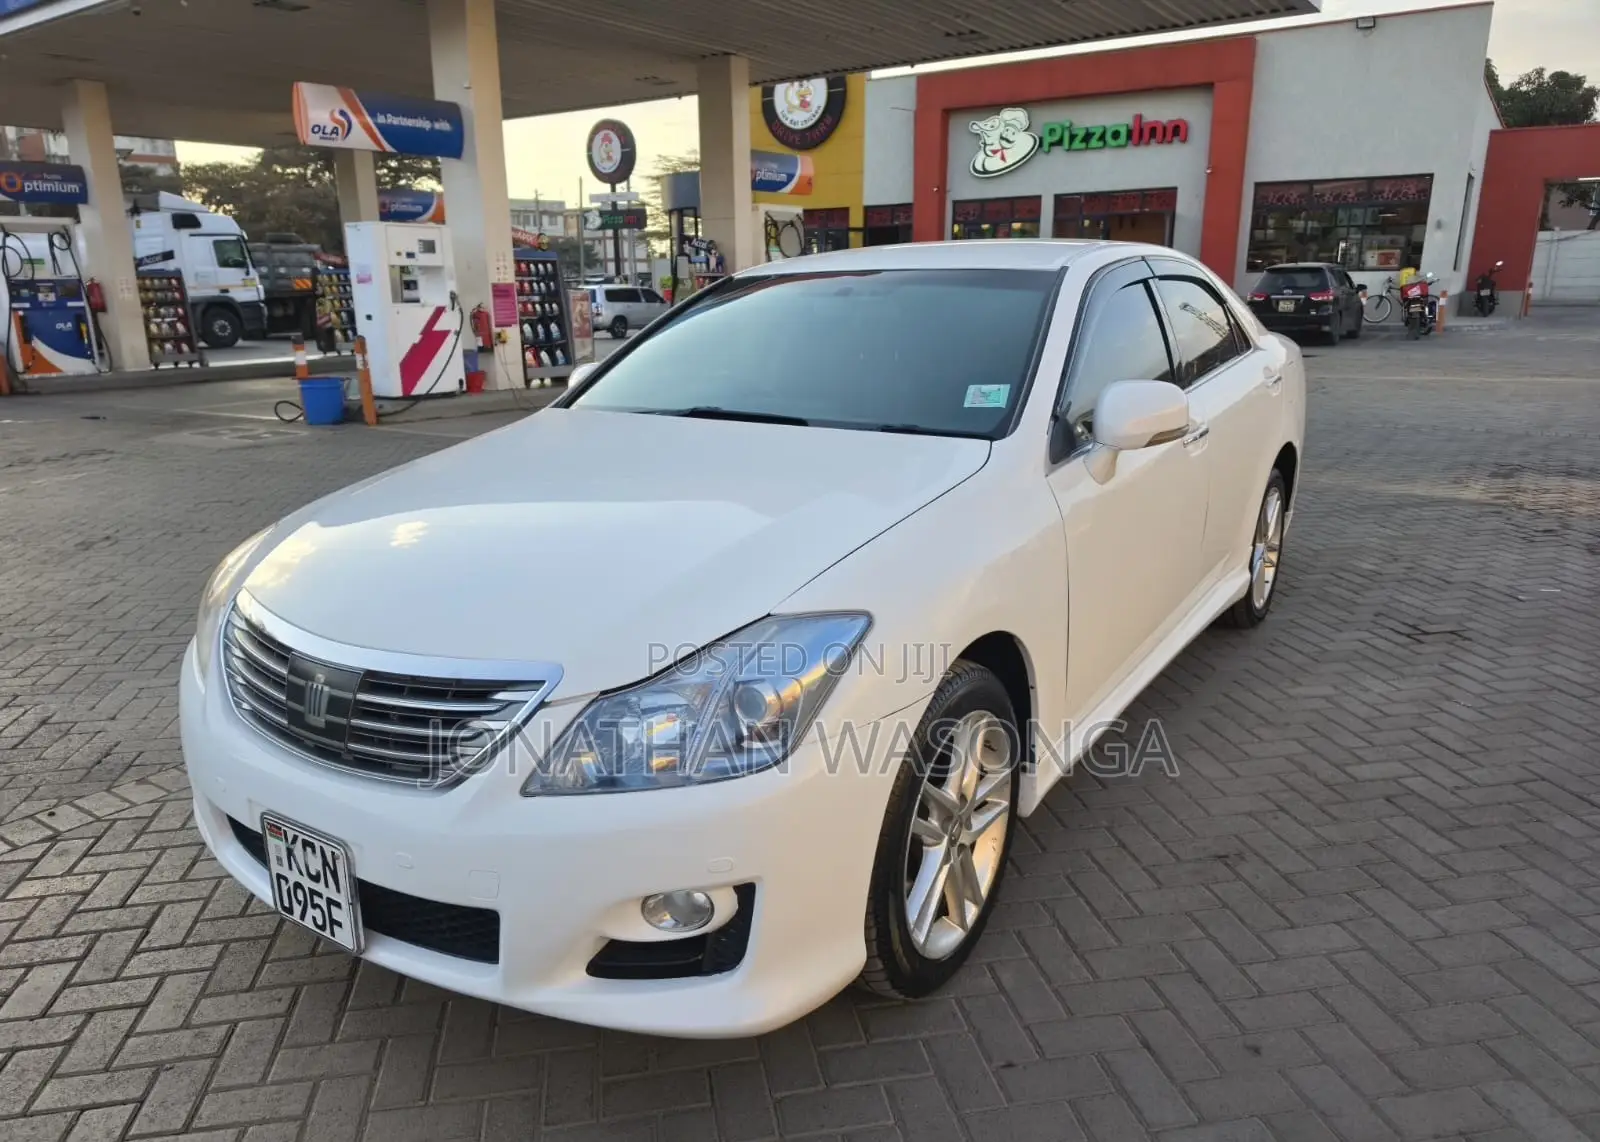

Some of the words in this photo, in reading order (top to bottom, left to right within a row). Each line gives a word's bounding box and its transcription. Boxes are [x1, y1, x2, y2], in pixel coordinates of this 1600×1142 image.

[311, 124, 339, 136] OLA
[55, 321, 73, 329] OLA
[283, 829, 341, 894] KCN
